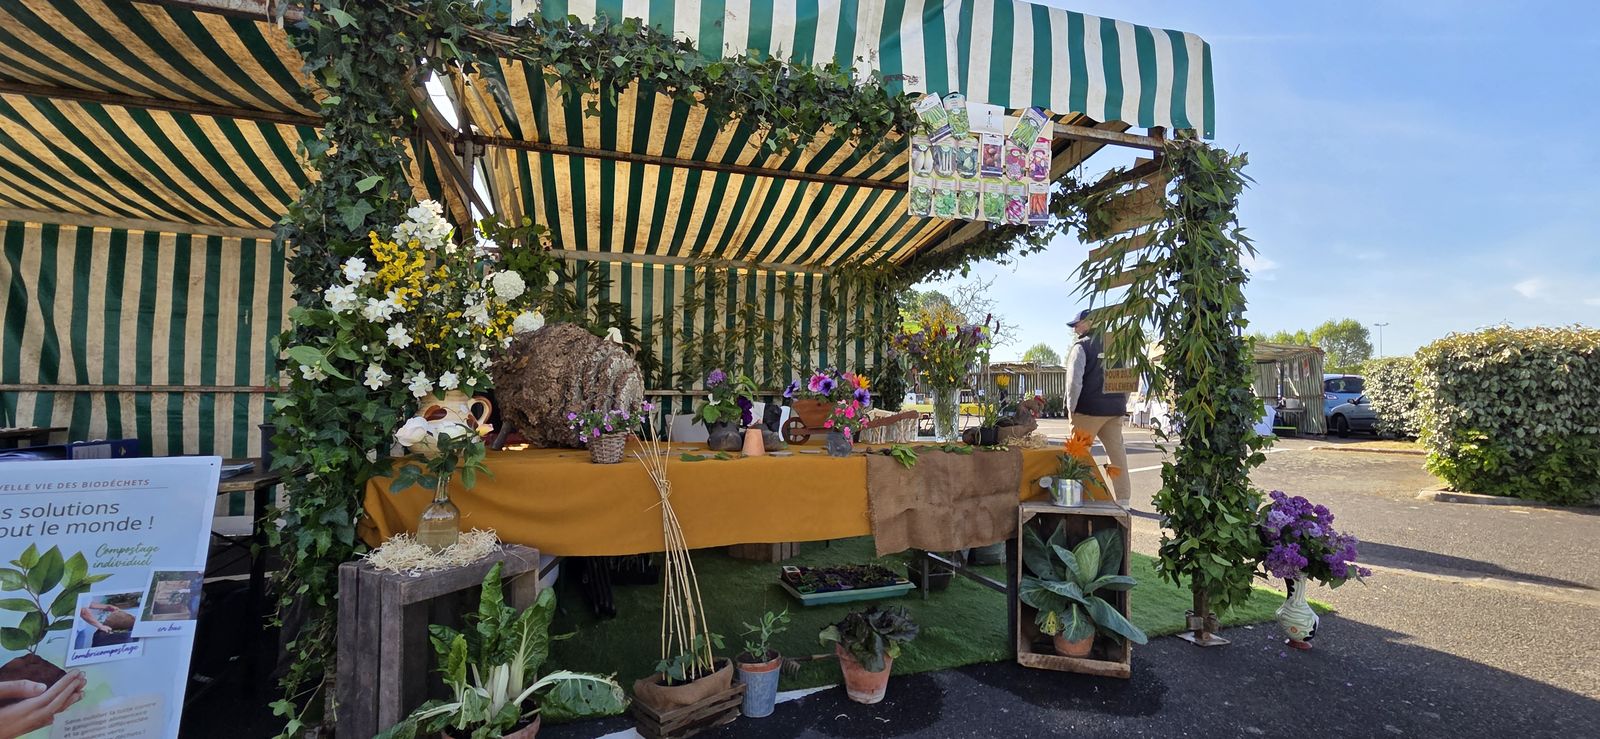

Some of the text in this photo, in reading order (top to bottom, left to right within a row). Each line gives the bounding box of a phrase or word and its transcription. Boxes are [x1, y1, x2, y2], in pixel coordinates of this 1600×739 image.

[35, 482, 53, 490] VIE
[57, 481, 77, 489] DES
[82, 478, 150, 489] BIODÉCHETS
[19, 502, 120, 519] solutions
[41, 520, 59, 536] le
[66, 516, 142, 534] monde
[95, 542, 160, 558] Compostage
[93, 554, 152, 569] individuel
